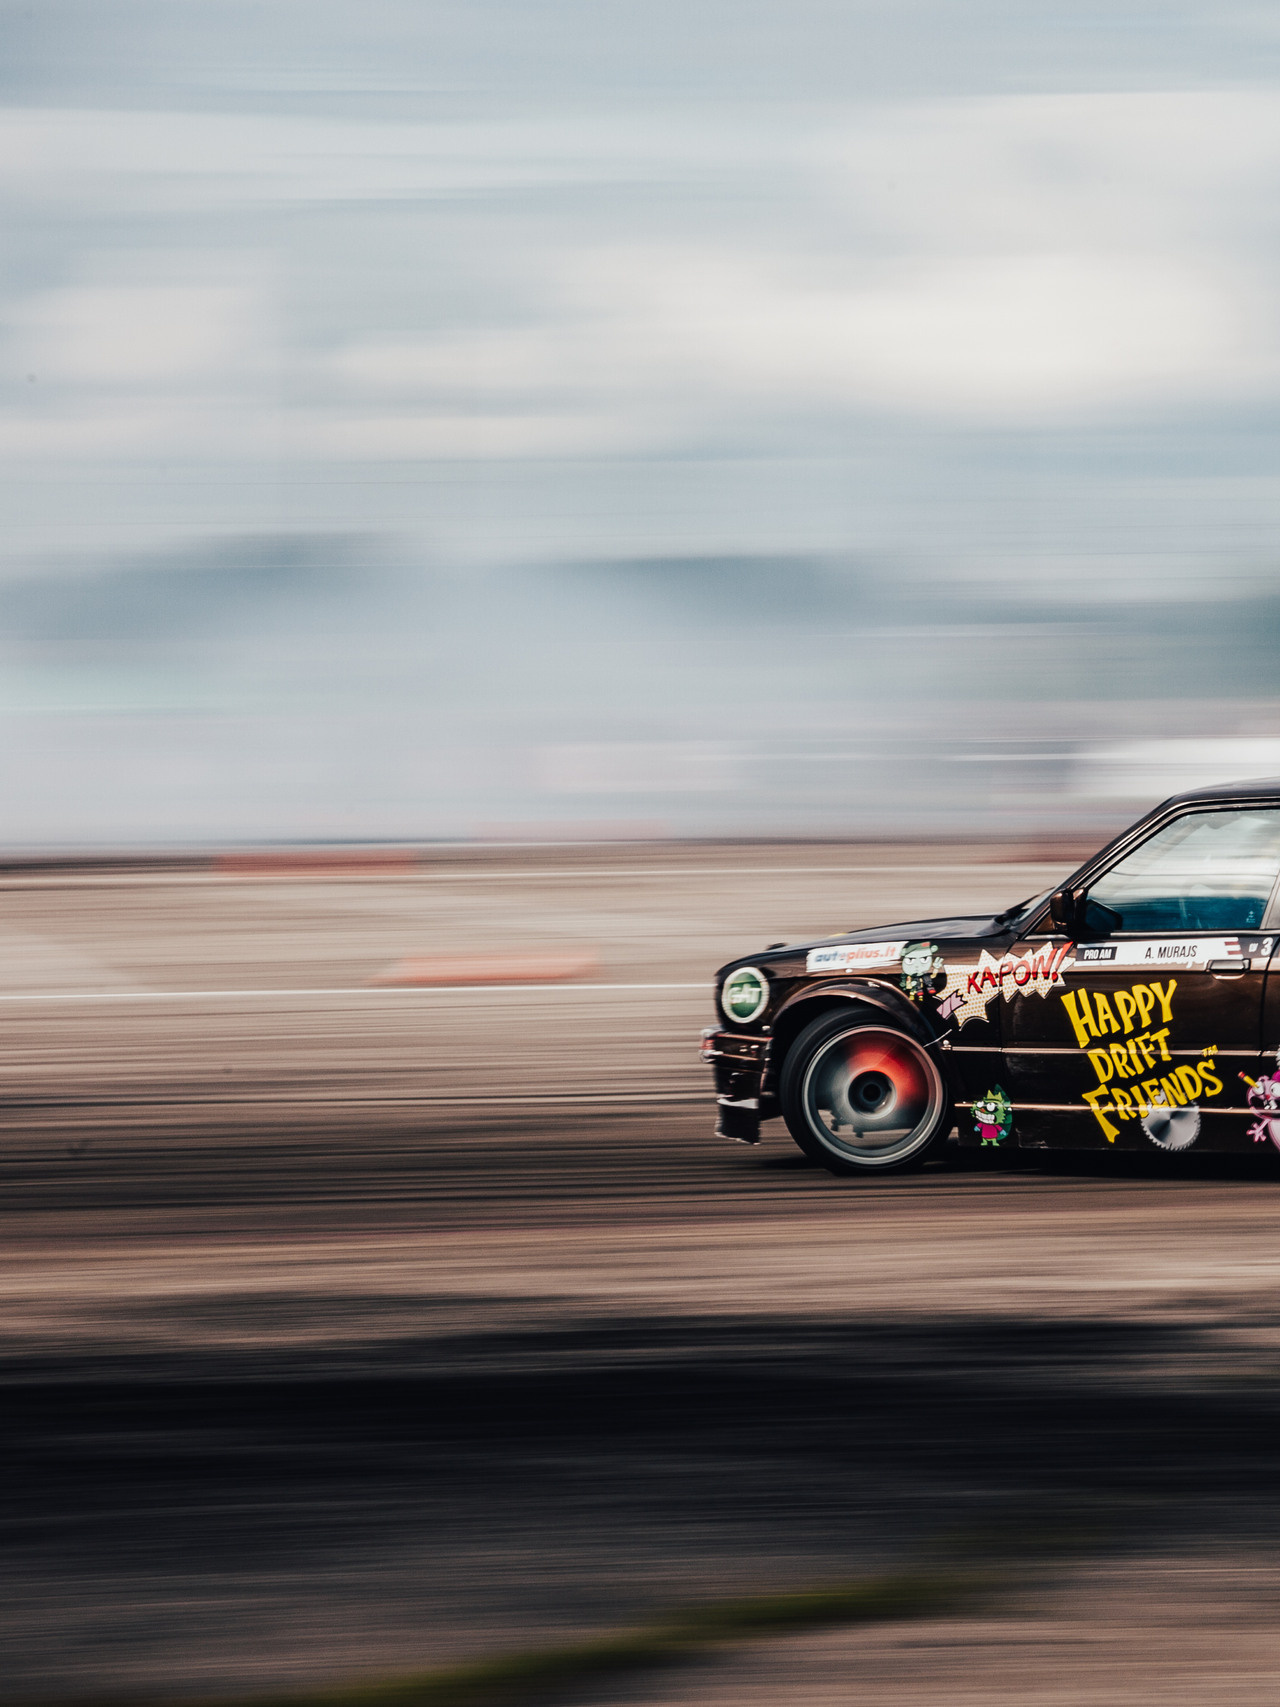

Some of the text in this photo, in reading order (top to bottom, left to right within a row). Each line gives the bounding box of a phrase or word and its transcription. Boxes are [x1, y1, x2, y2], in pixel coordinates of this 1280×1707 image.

[1083, 948, 1112, 960] PRO AM
[1145, 945, 1198, 959] A. MURAJS
[1260, 937, 1273, 956] 3
[1060, 979, 1177, 1048] HAPPY
[1087, 1027, 1172, 1084] DRIFT
[1081, 1059, 1223, 1143] FRIENDS
